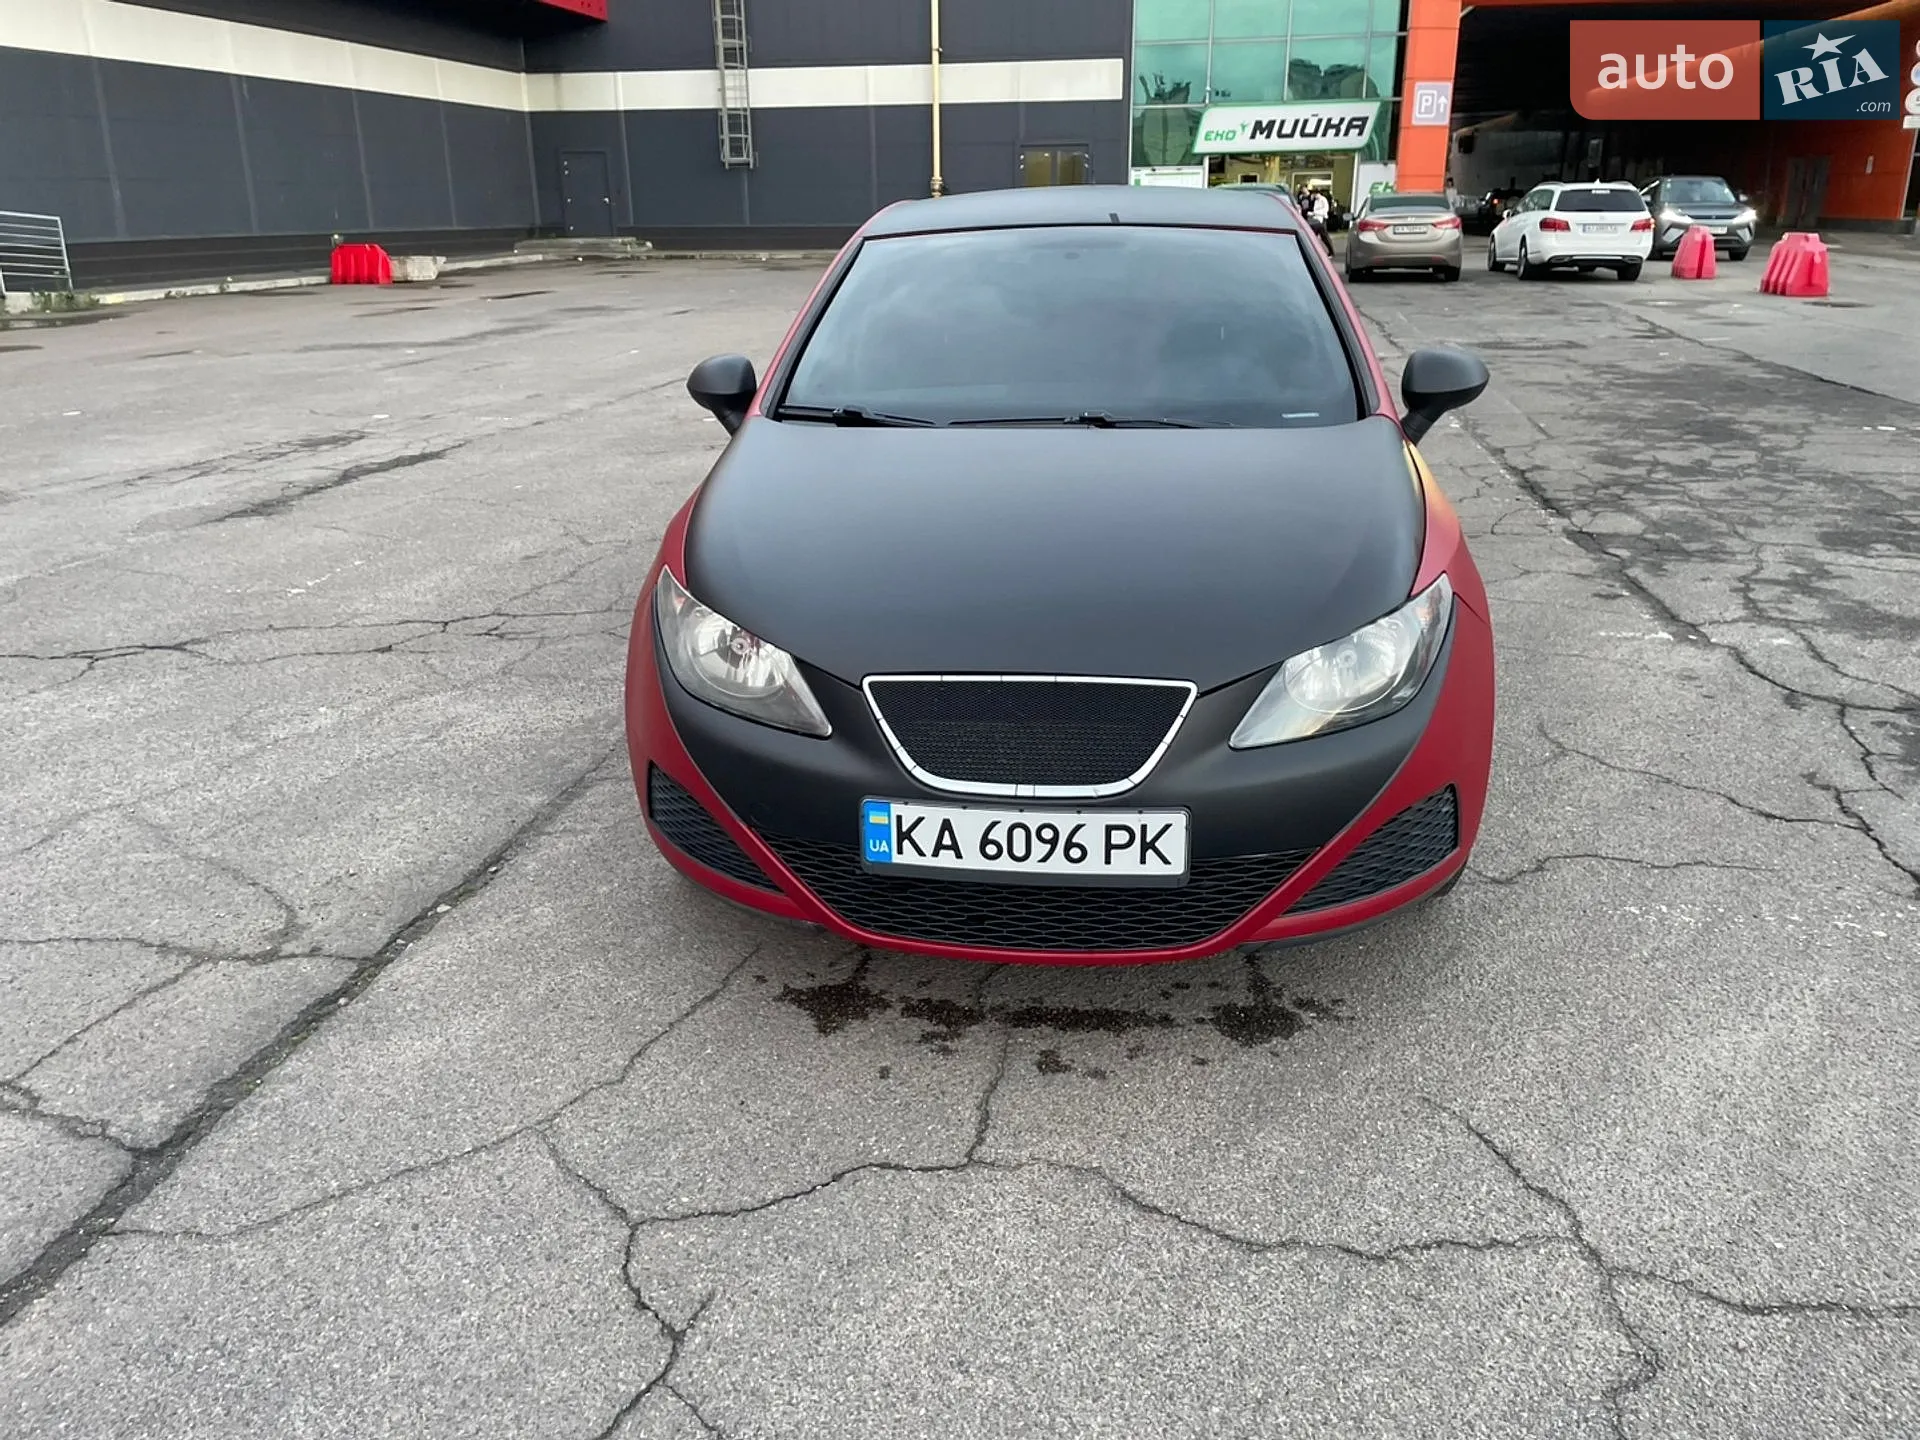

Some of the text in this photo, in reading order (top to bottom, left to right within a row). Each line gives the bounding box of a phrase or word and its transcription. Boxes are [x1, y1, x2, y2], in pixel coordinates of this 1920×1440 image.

[1249, 113, 1370, 140] МИЙКА
[869, 838, 890, 854] UA
[895, 814, 1173, 866] KA 6096 PK
